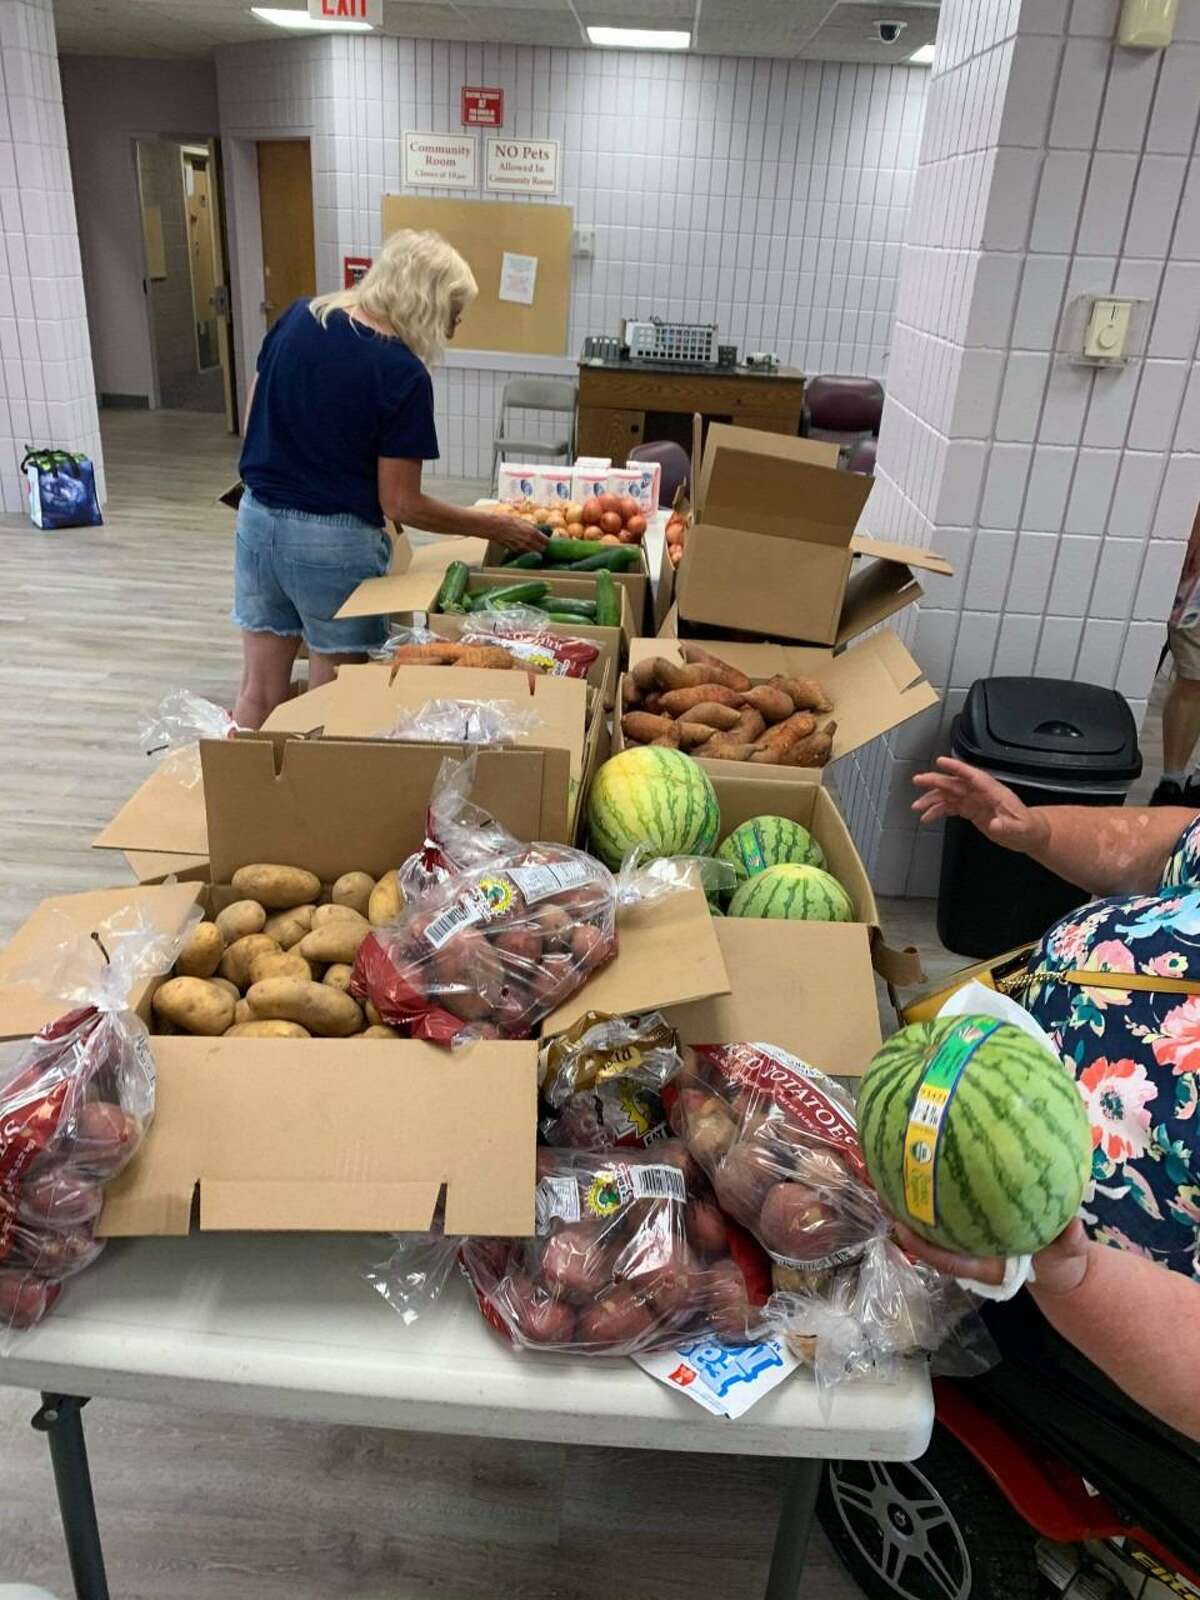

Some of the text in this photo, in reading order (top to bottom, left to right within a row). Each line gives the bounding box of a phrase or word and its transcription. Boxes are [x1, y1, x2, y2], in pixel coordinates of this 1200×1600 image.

[410, 143, 470, 159] Community
[495, 144, 550, 161] NO Pets
[426, 155, 456, 167] Room
